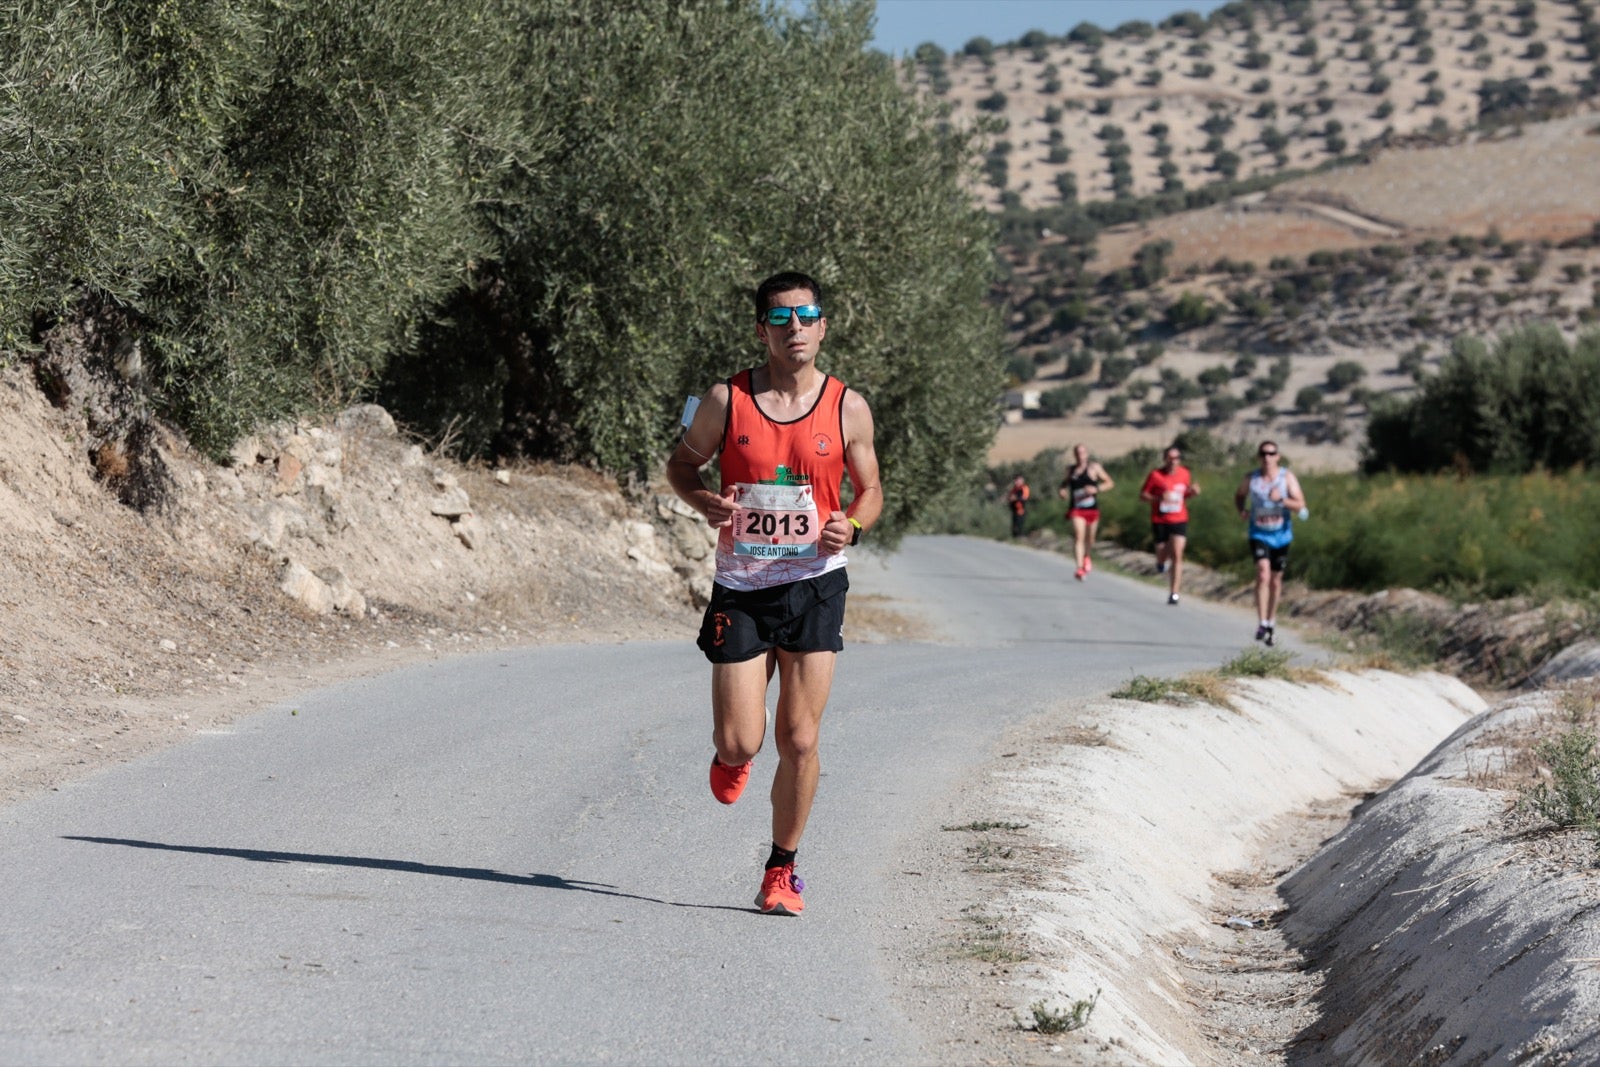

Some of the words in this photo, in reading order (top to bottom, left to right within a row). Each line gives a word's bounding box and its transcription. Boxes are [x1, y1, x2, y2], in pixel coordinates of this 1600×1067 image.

[746, 512, 809, 536] 2013
[750, 546, 765, 556] JOSE
[768, 546, 799, 556] ANTONIO
